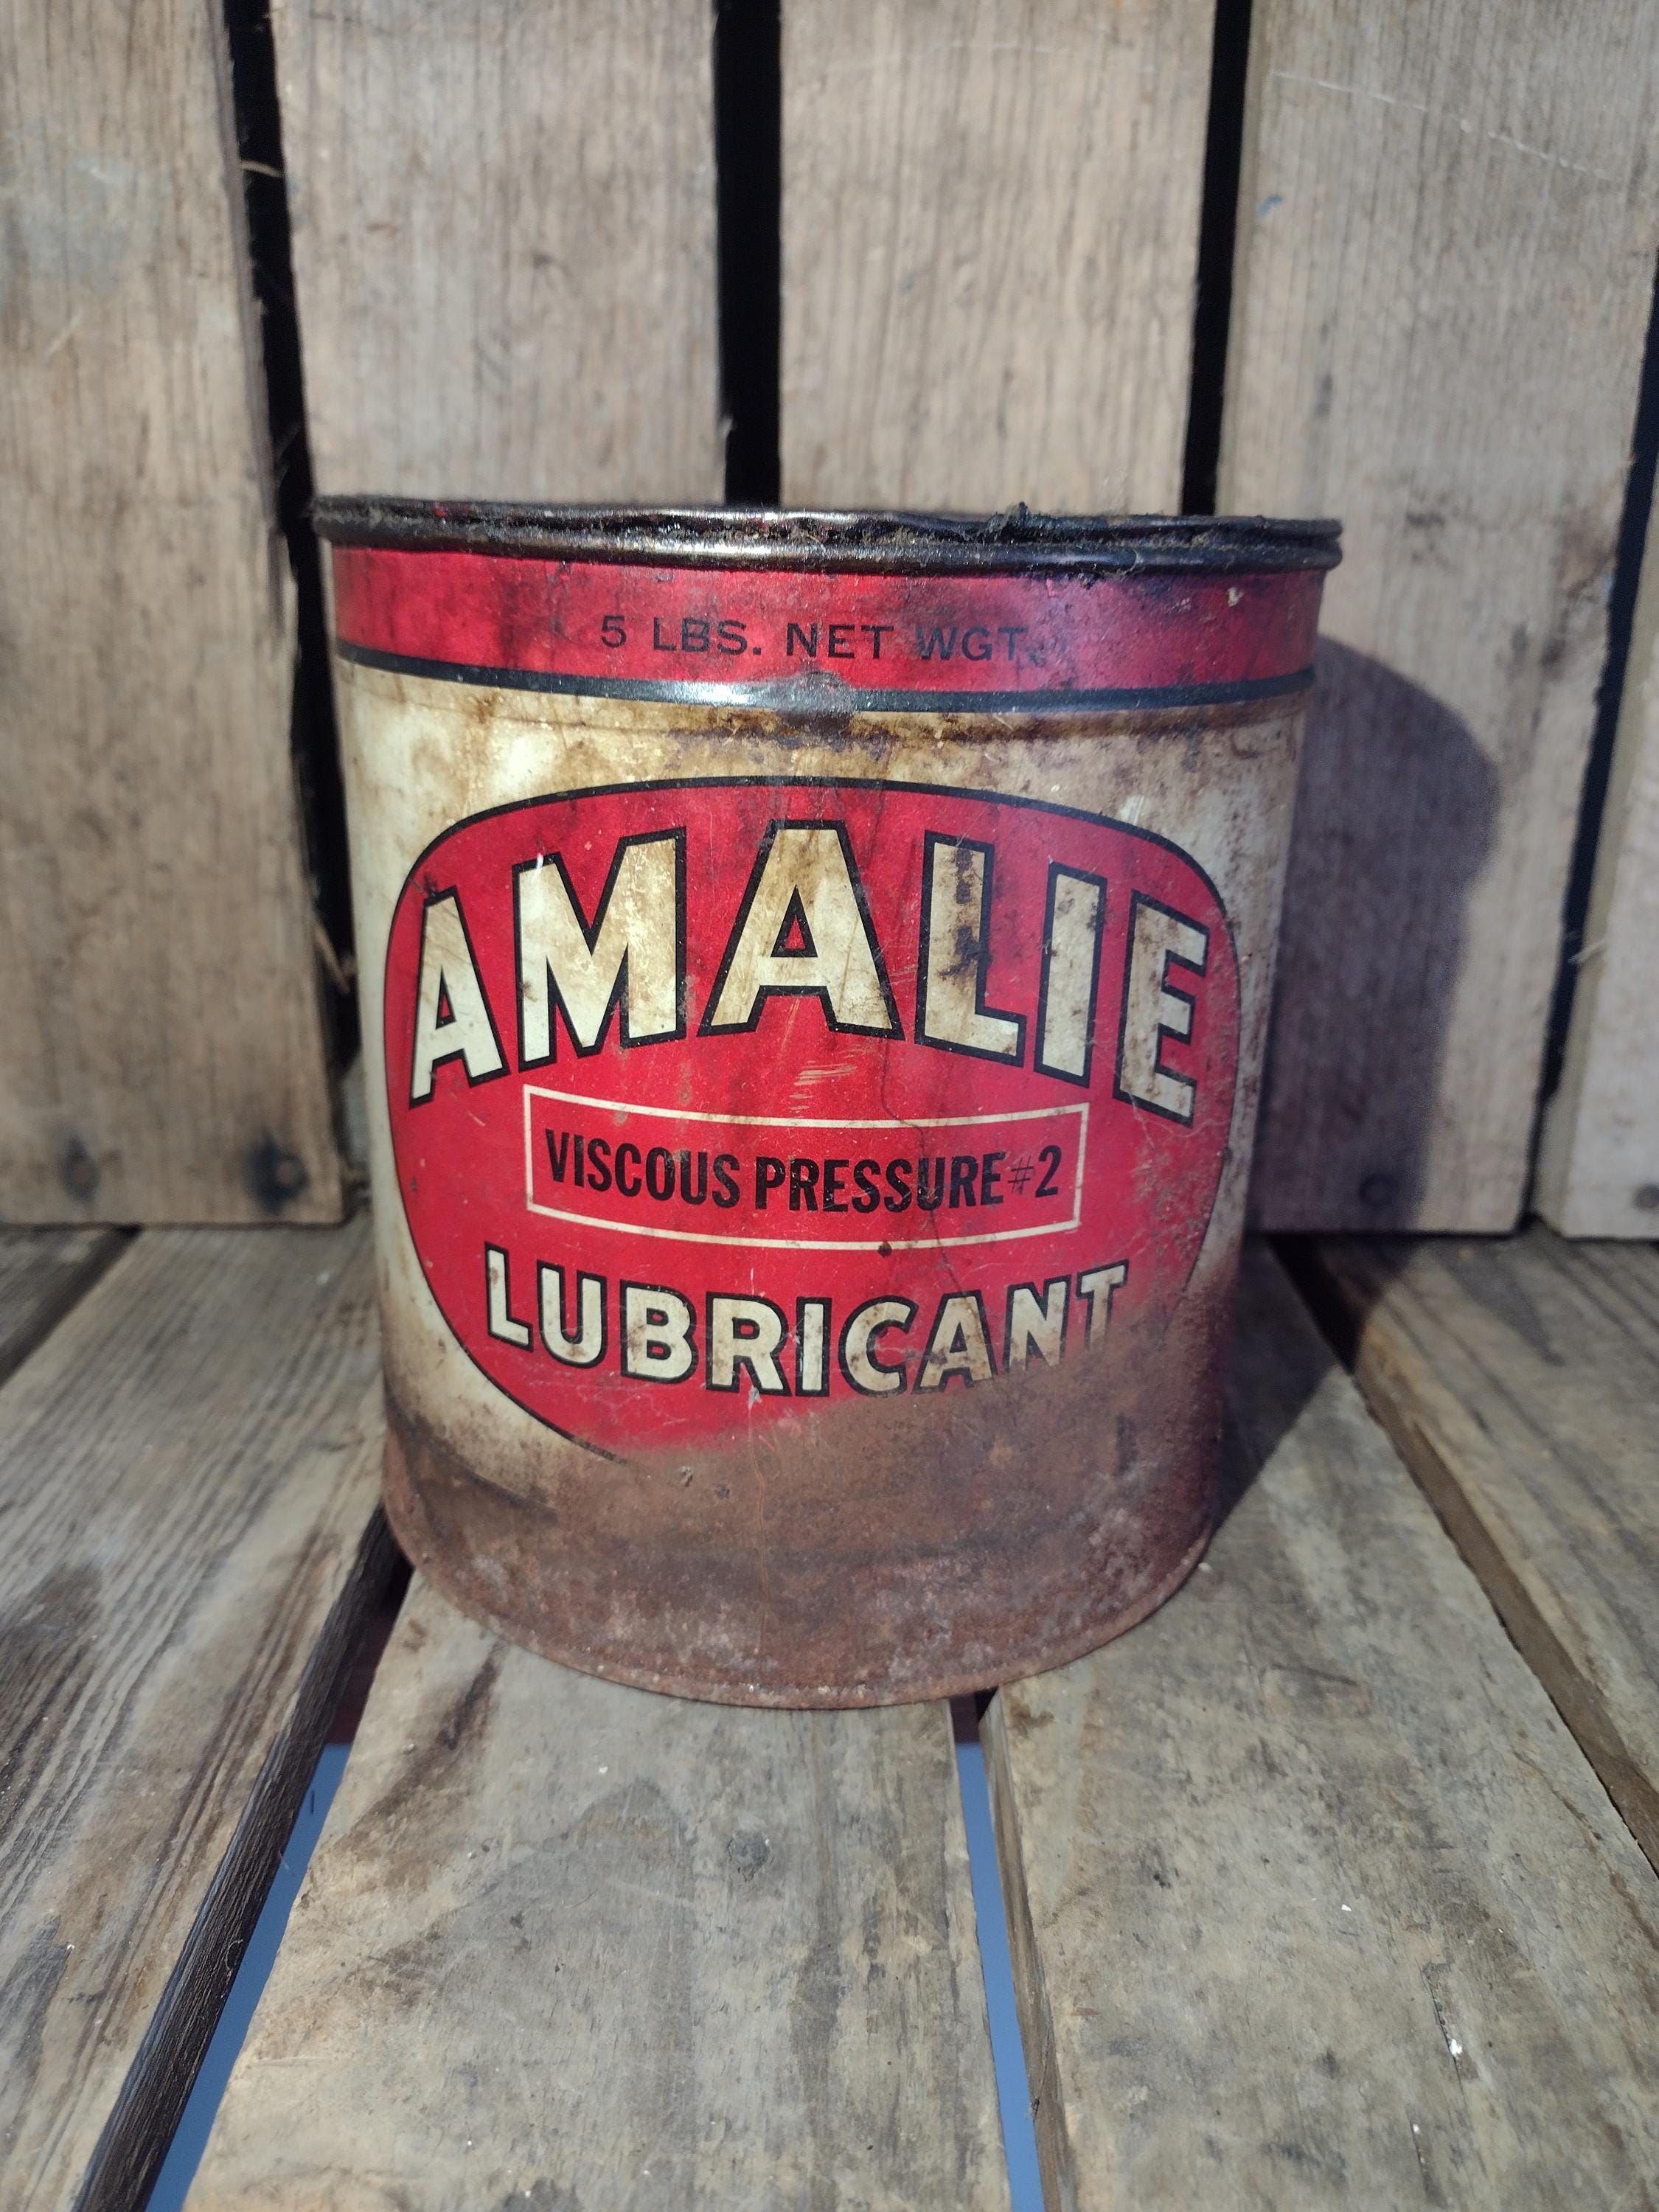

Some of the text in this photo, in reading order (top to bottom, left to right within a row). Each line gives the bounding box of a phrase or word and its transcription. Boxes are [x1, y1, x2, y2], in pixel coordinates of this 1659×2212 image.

[600, 615, 627, 649] 5
[652, 616, 762, 656] LBS.
[786, 622, 894, 660] NET
[407, 818, 1211, 1129] AMALIE
[545, 1128, 740, 1211] VISCOUS
[754, 1152, 1005, 1214] PRESSURE
[484, 1240, 1130, 1398] LUBRICANT
